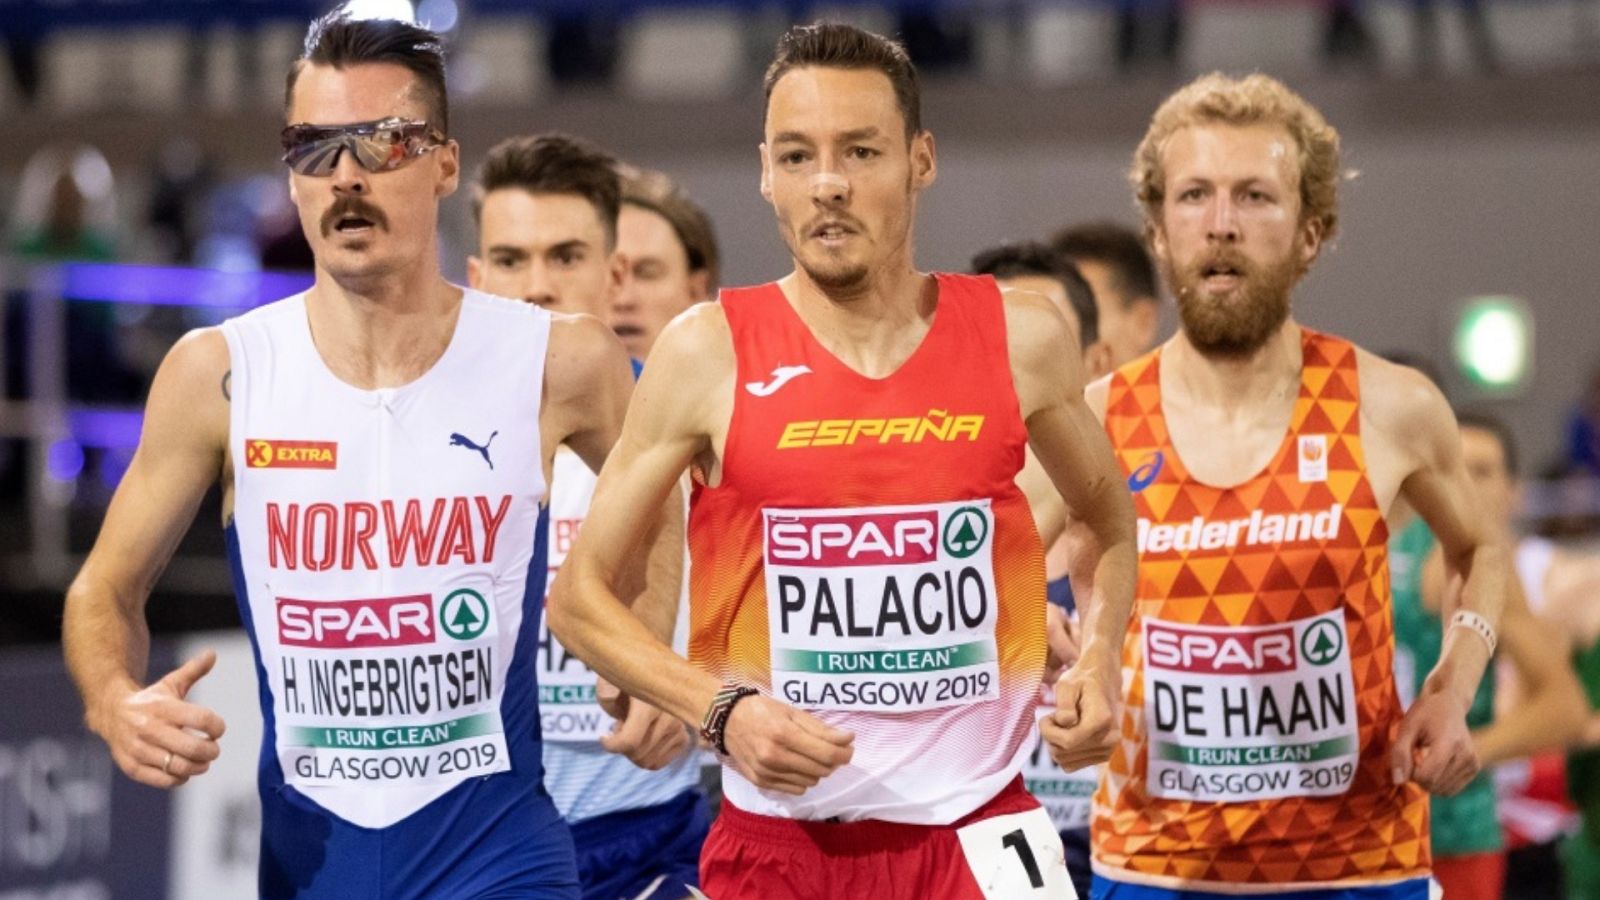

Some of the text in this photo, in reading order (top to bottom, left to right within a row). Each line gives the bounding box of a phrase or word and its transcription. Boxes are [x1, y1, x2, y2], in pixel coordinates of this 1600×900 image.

[776, 409, 985, 449] ESPAÑA
[276, 447, 334, 462] EXTRA
[266, 495, 513, 572] NORWAY
[771, 519, 934, 560] SPAR
[778, 566, 988, 637] PALACIO
[279, 601, 431, 642] SPAR
[829, 653, 876, 671] RUN
[1149, 631, 1293, 670] SPAR
[282, 656, 305, 715] H.
[309, 647, 492, 717] INGEBRIGTSEN
[783, 671, 991, 706] GLASGOW 2019
[1154, 673, 1346, 738] DE HAAN
[337, 731, 377, 747] RUN
[1199, 748, 1240, 765] RUN
[294, 743, 497, 781] GLASGOW 2019
[1159, 762, 1352, 794] GLASGOW 2019
[1002, 828, 1044, 889] 1
